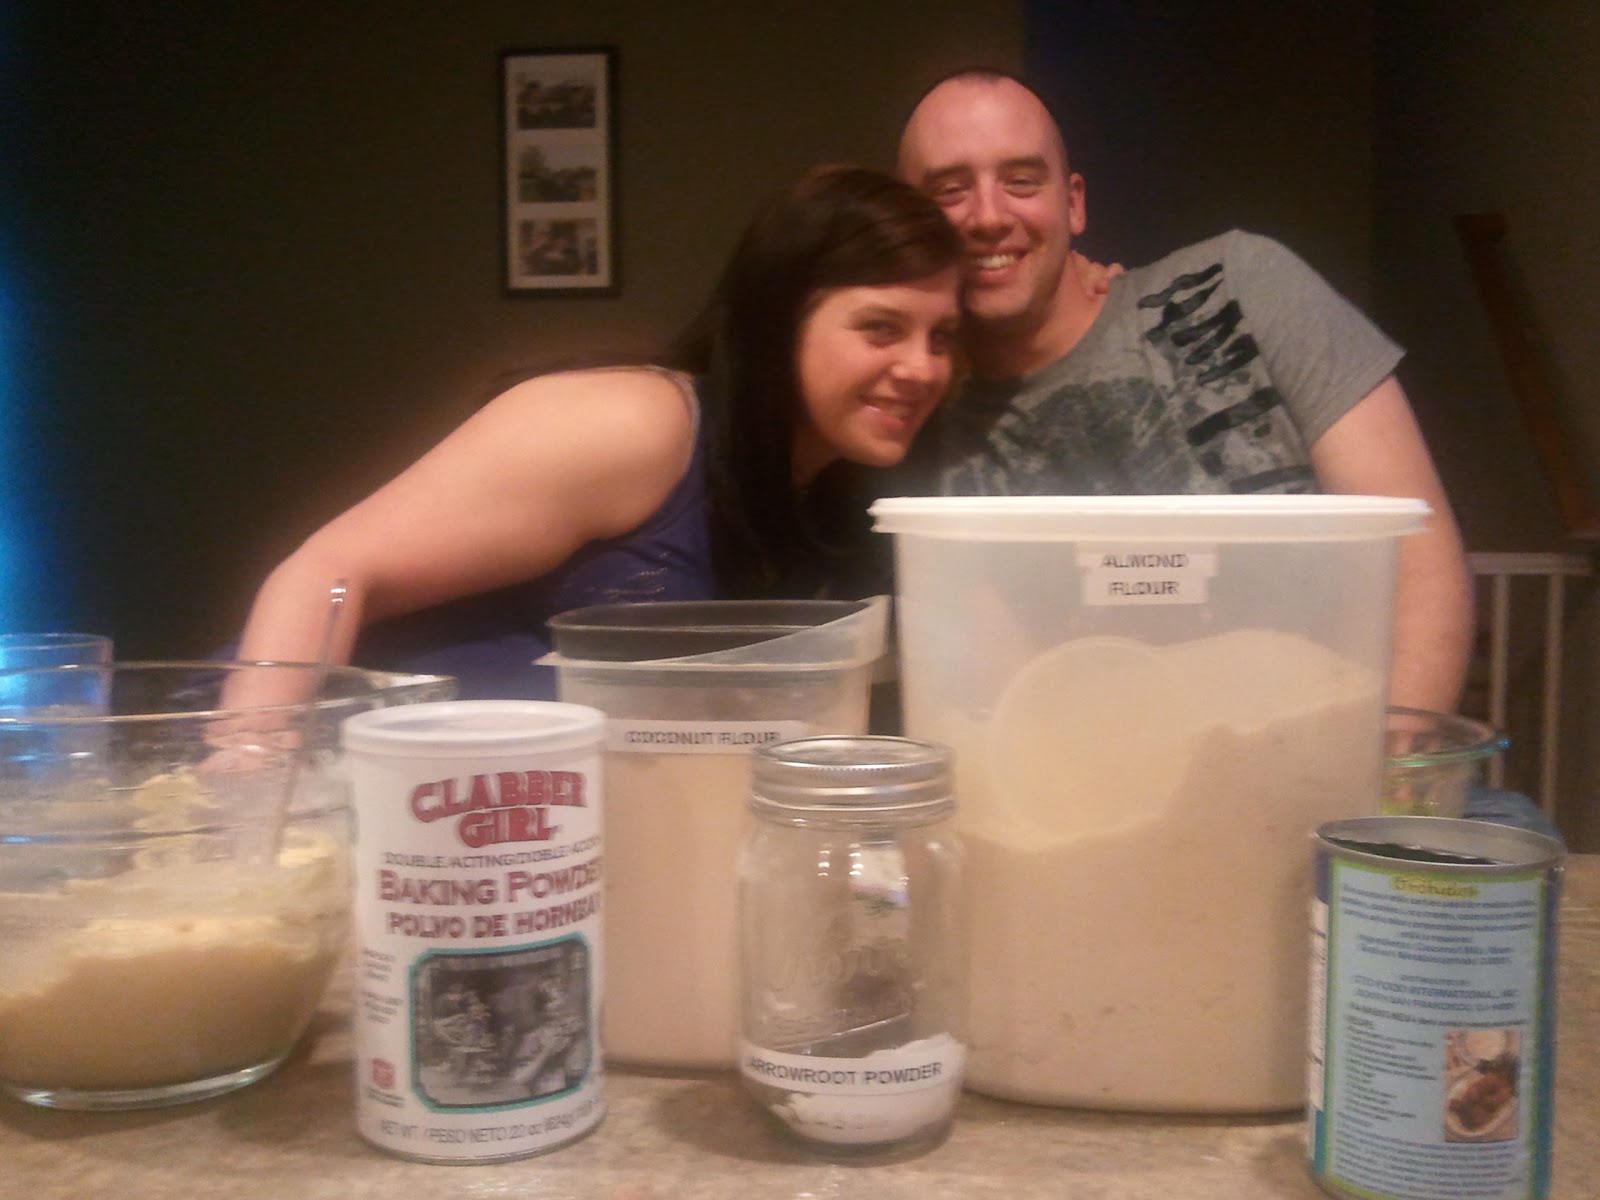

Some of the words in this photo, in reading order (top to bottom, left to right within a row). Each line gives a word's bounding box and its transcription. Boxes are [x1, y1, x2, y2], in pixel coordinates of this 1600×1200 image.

[1101, 553, 1189, 569] ALMOND
[1108, 581, 1180, 596] FLOUR
[625, 731, 714, 745] COCONUT
[716, 731, 781, 746] FLOUR
[410, 769, 588, 823] CLABBER
[459, 807, 562, 848] GIRL
[385, 851, 447, 869] DOUBLE
[379, 869, 498, 907] BAKING
[386, 911, 467, 940] POLVO
[472, 912, 506, 940] DE
[745, 1056, 857, 1085] ARROWROOT
[862, 1061, 943, 1084] POWDER
